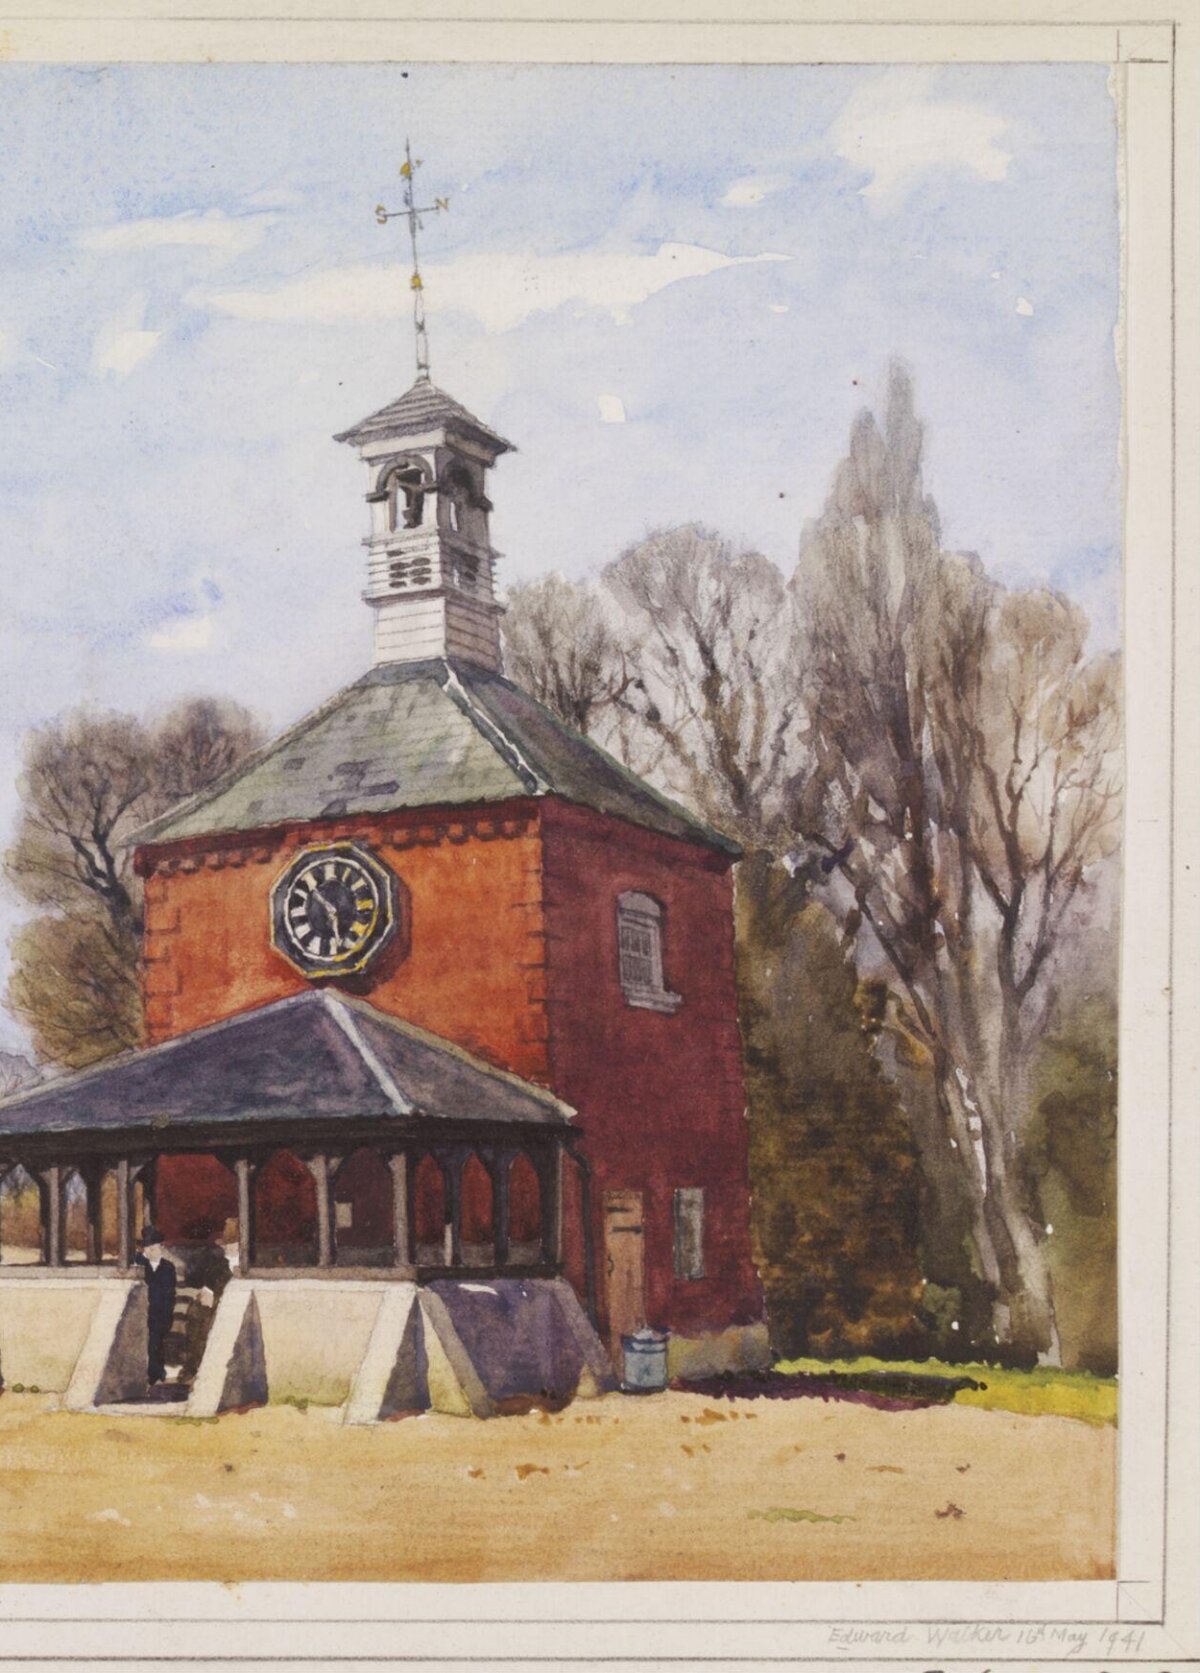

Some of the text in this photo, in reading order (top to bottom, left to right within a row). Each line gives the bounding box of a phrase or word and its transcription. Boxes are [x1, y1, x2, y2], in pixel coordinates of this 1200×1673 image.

[827, 1626, 911, 1646] Edward
[927, 1624, 1010, 1648] Walker
[1050, 1627, 1088, 1657] May
[1099, 1627, 1146, 1656] 1941
